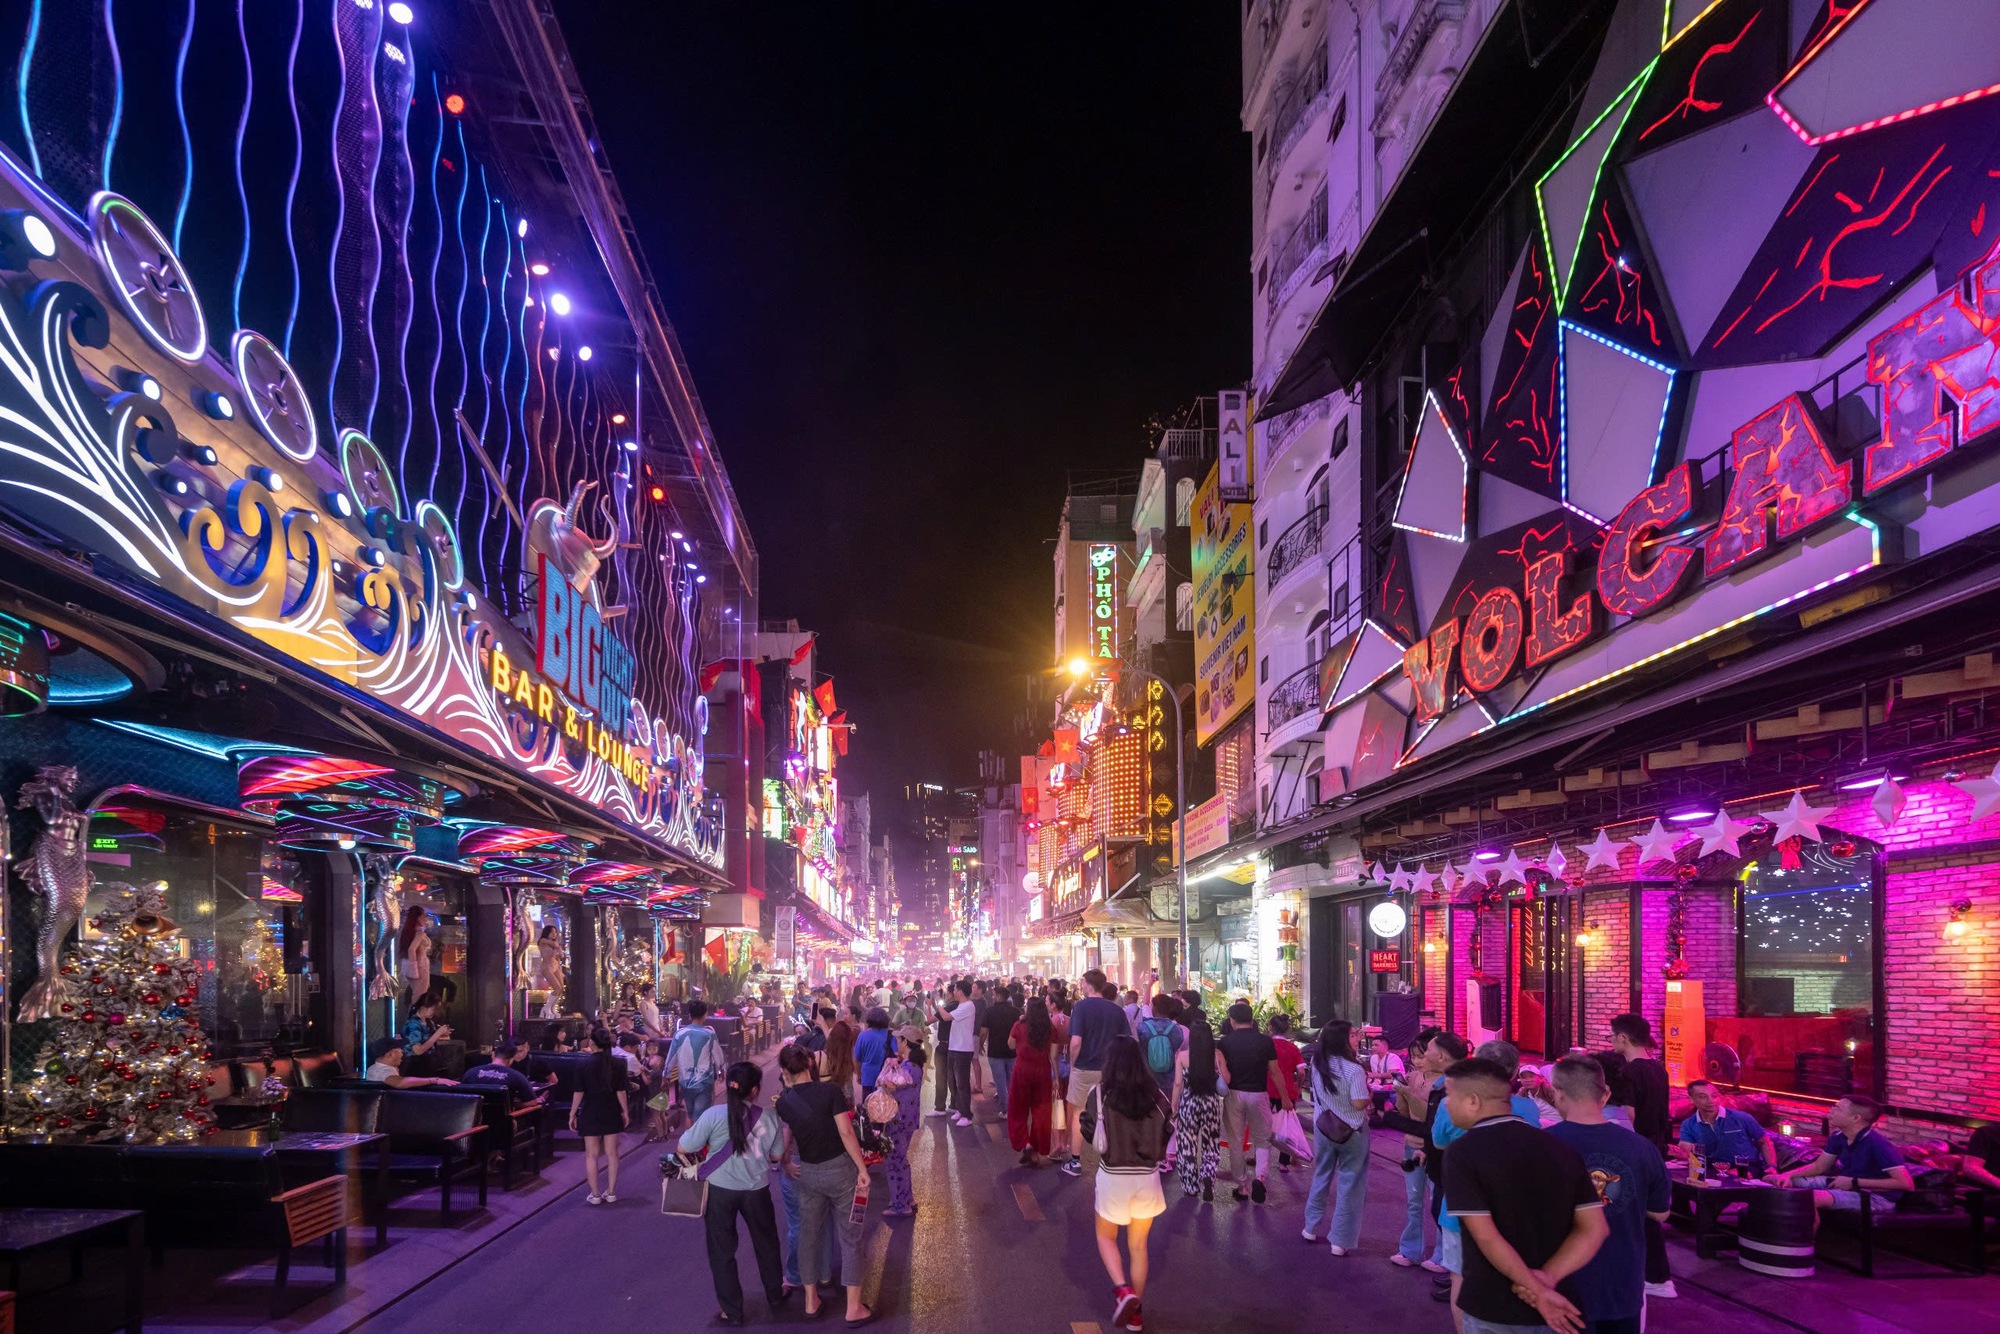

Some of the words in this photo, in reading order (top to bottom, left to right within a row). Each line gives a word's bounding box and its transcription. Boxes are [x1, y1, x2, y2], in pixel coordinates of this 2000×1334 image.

[1223, 394, 1242, 483] BALI
[1220, 486, 1247, 497] HOTEL
[537, 553, 601, 715] BIG
[601, 623, 635, 698] NIGHT
[1233, 613, 1247, 642] NAM
[493, 649, 554, 724] BAR
[565, 705, 579, 740] &
[587, 719, 651, 792] LOUNGE
[600, 675, 631, 741] OUT
[1373, 953, 1397, 962] HEART
